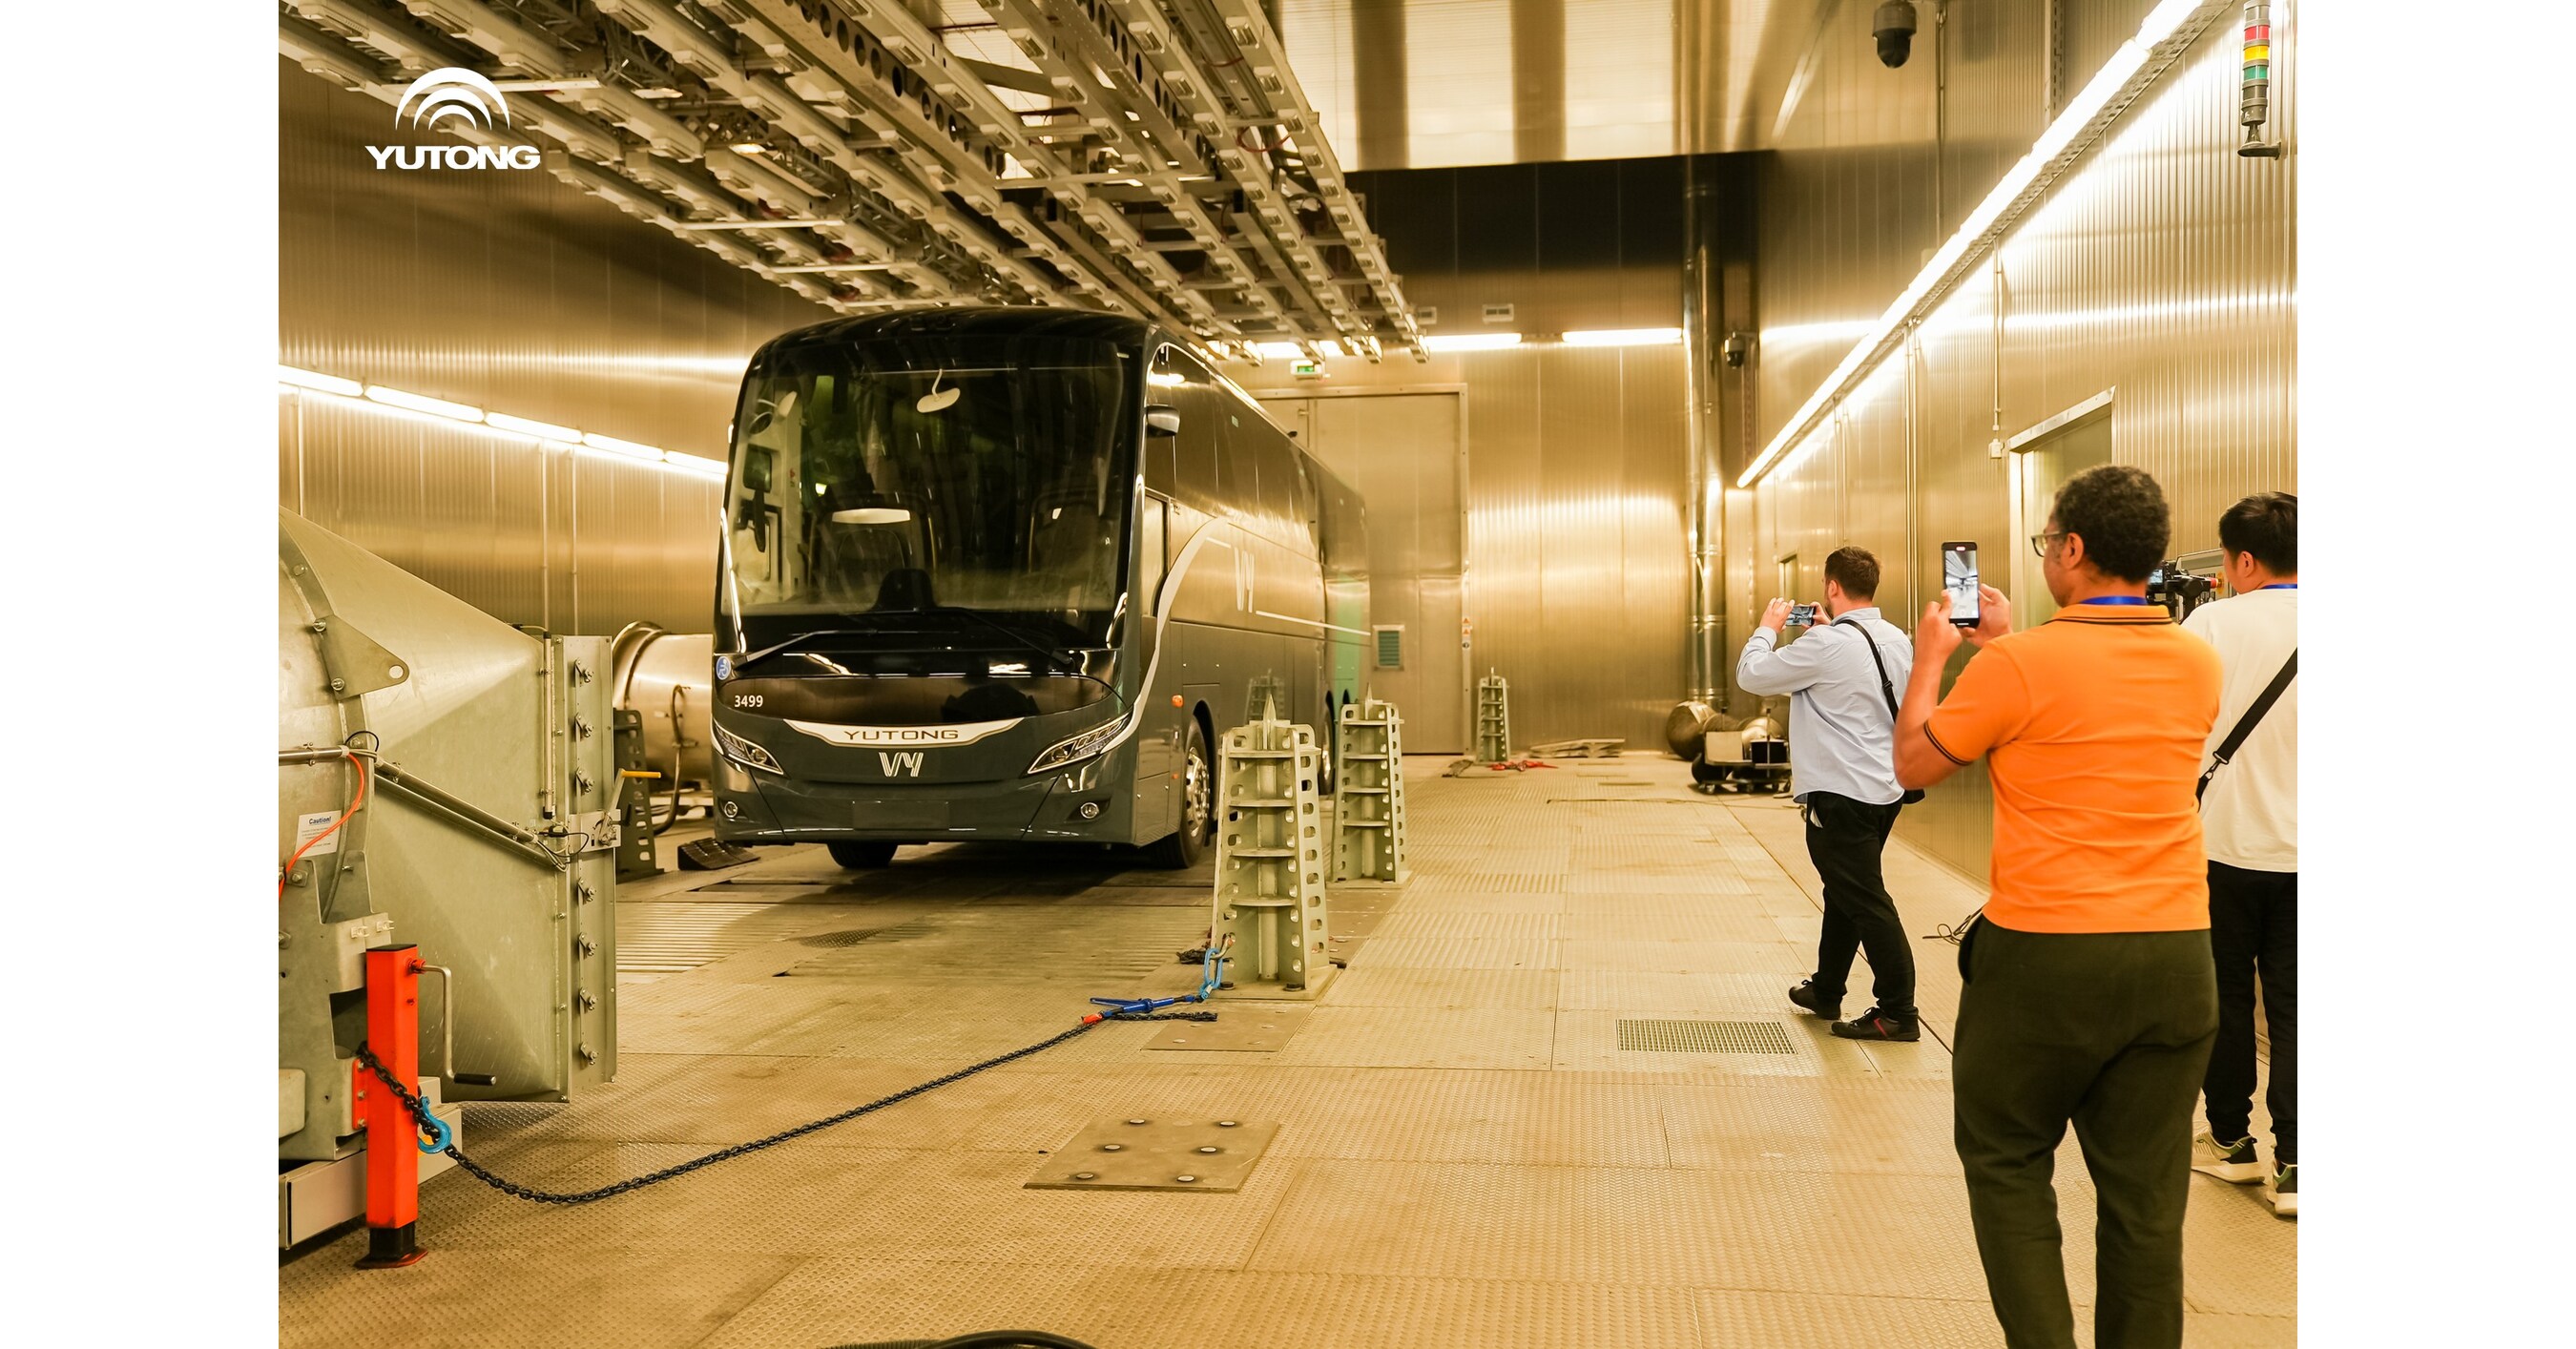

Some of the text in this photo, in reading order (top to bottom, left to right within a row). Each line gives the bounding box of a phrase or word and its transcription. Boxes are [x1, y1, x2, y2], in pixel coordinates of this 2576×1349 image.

[734, 695, 763, 707] 3499
[844, 730, 959, 740] YUTONG
[308, 816, 332, 824] Caution!
